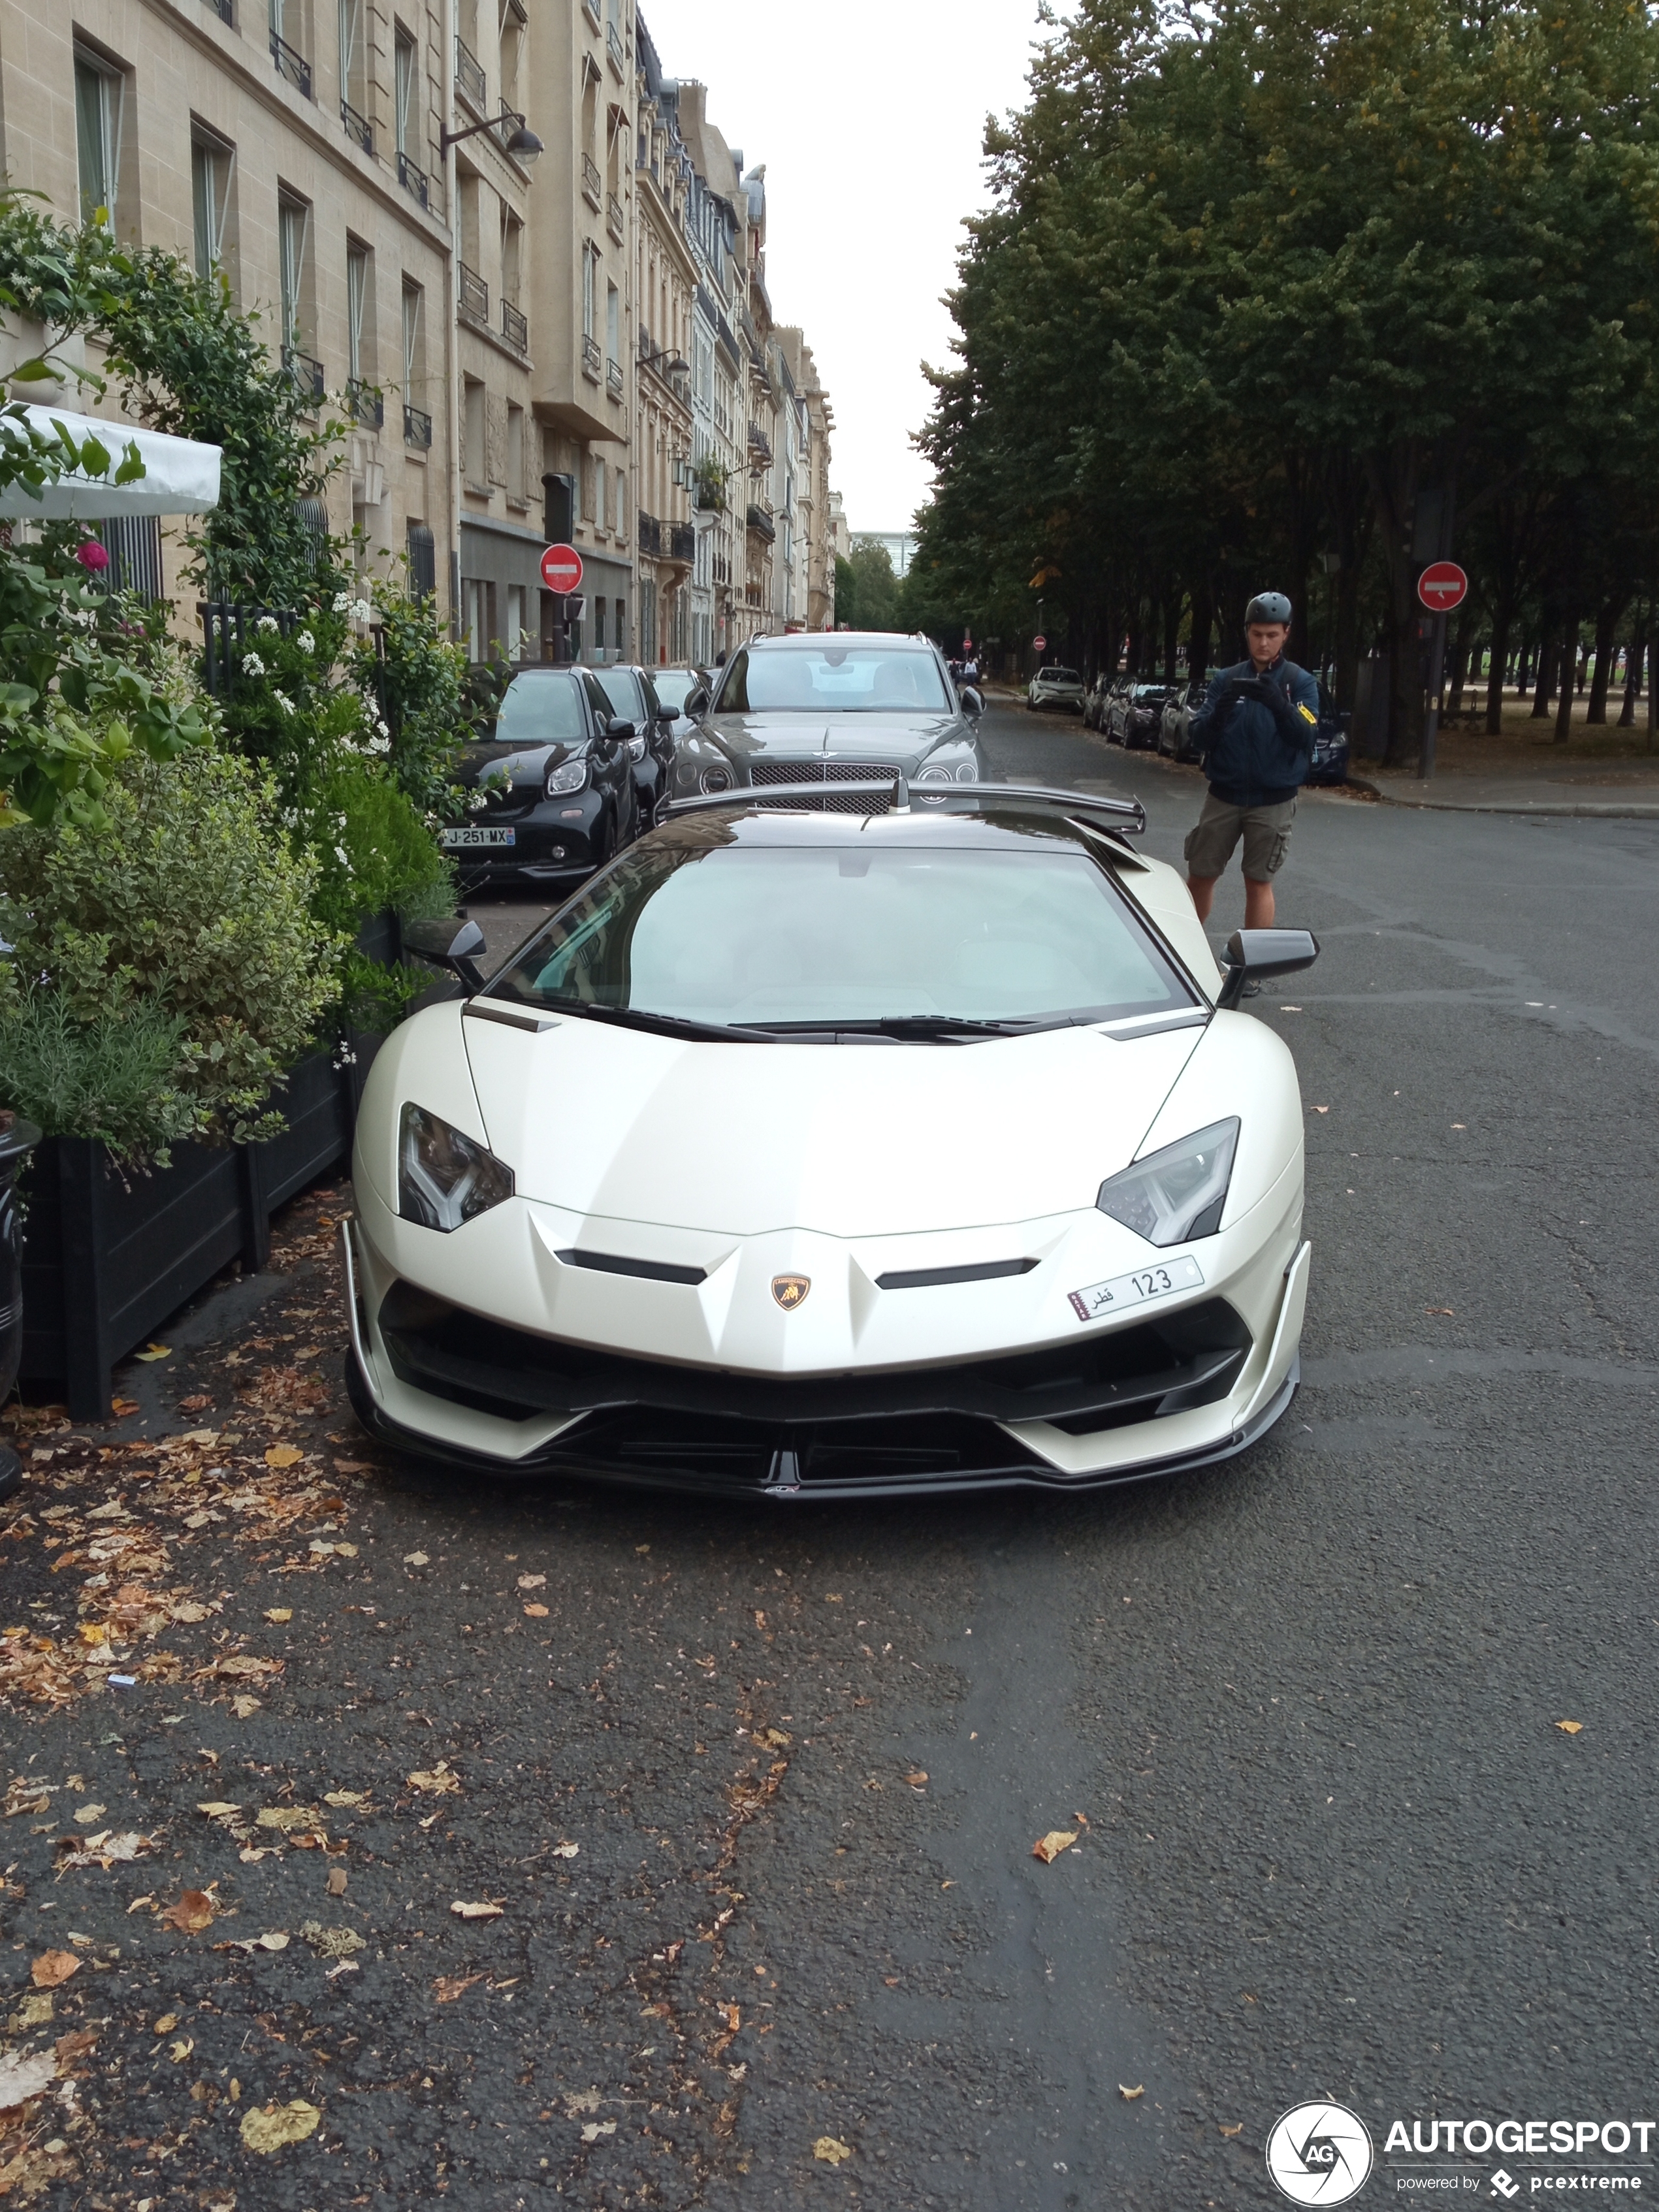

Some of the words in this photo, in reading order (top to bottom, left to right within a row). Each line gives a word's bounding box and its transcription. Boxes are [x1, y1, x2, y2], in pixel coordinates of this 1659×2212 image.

[1131, 1269, 1172, 1296] 123
[1071, 1294, 1087, 1319] QATAR
[1091, 1288, 1114, 1309] قطر
